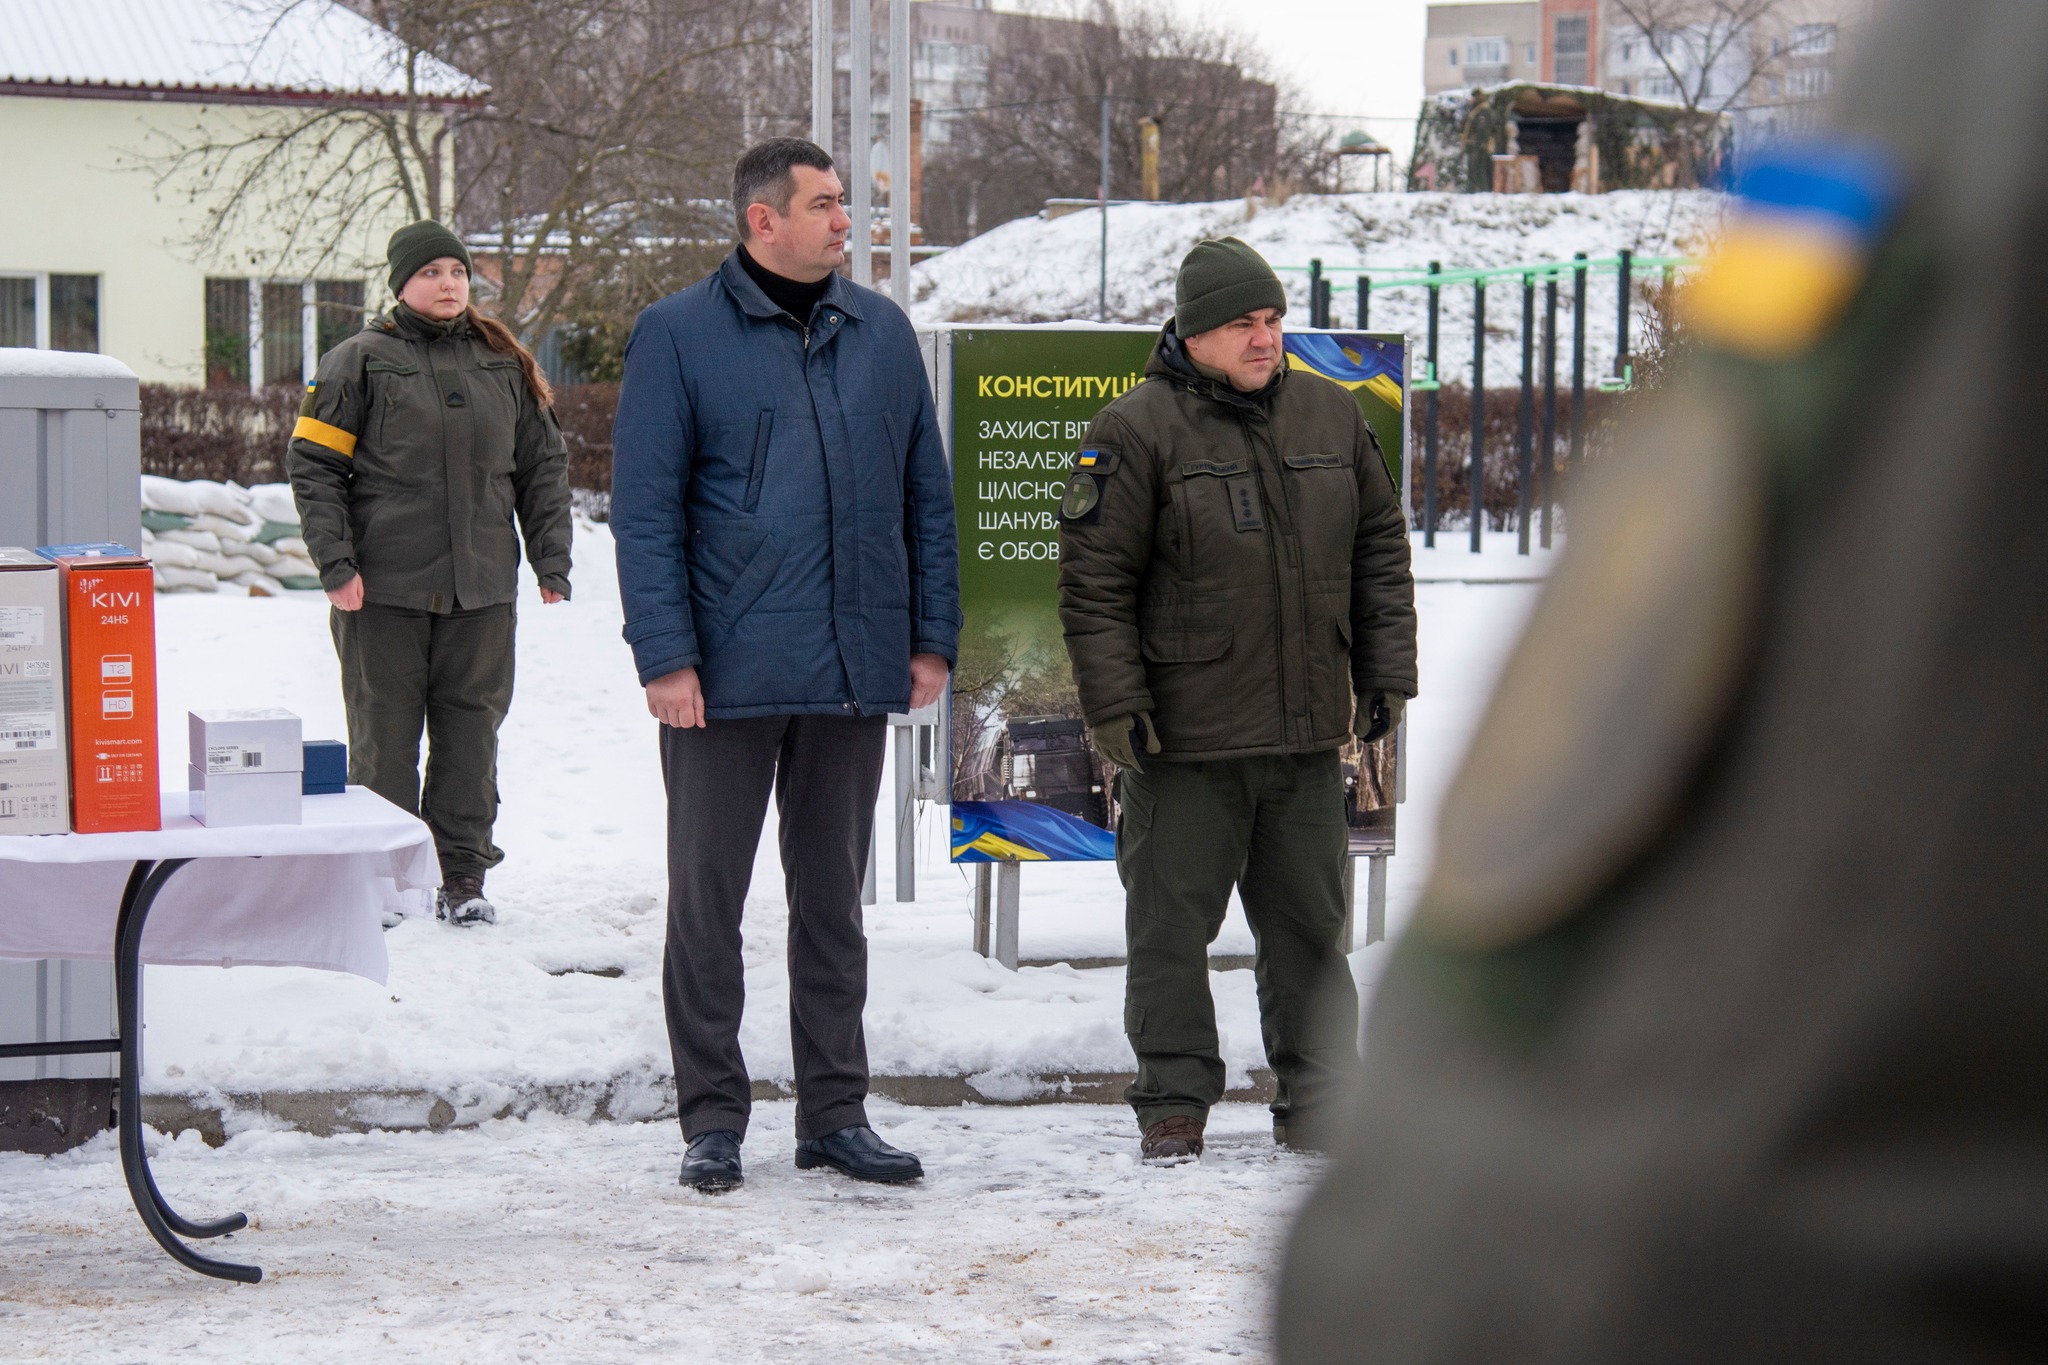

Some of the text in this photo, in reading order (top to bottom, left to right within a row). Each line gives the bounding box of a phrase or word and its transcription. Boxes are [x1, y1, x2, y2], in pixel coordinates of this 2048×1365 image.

[978, 372, 1147, 398] КОНСТИТУЦі
[978, 420, 1091, 440] ЗАХИСТ ВІТ
[979, 451, 1076, 470] НЕЗАЛЕЖ
[979, 481, 1066, 502] ЦІЛІСНО
[978, 541, 1060, 560] Є ОБОВ
[92, 592, 140, 608] KIVI
[101, 615, 129, 625] 24H5
[5, 644, 32, 653] 24H7
[109, 664, 126, 674] T2
[108, 700, 127, 710] HD
[95, 738, 143, 746] kivismart.com
